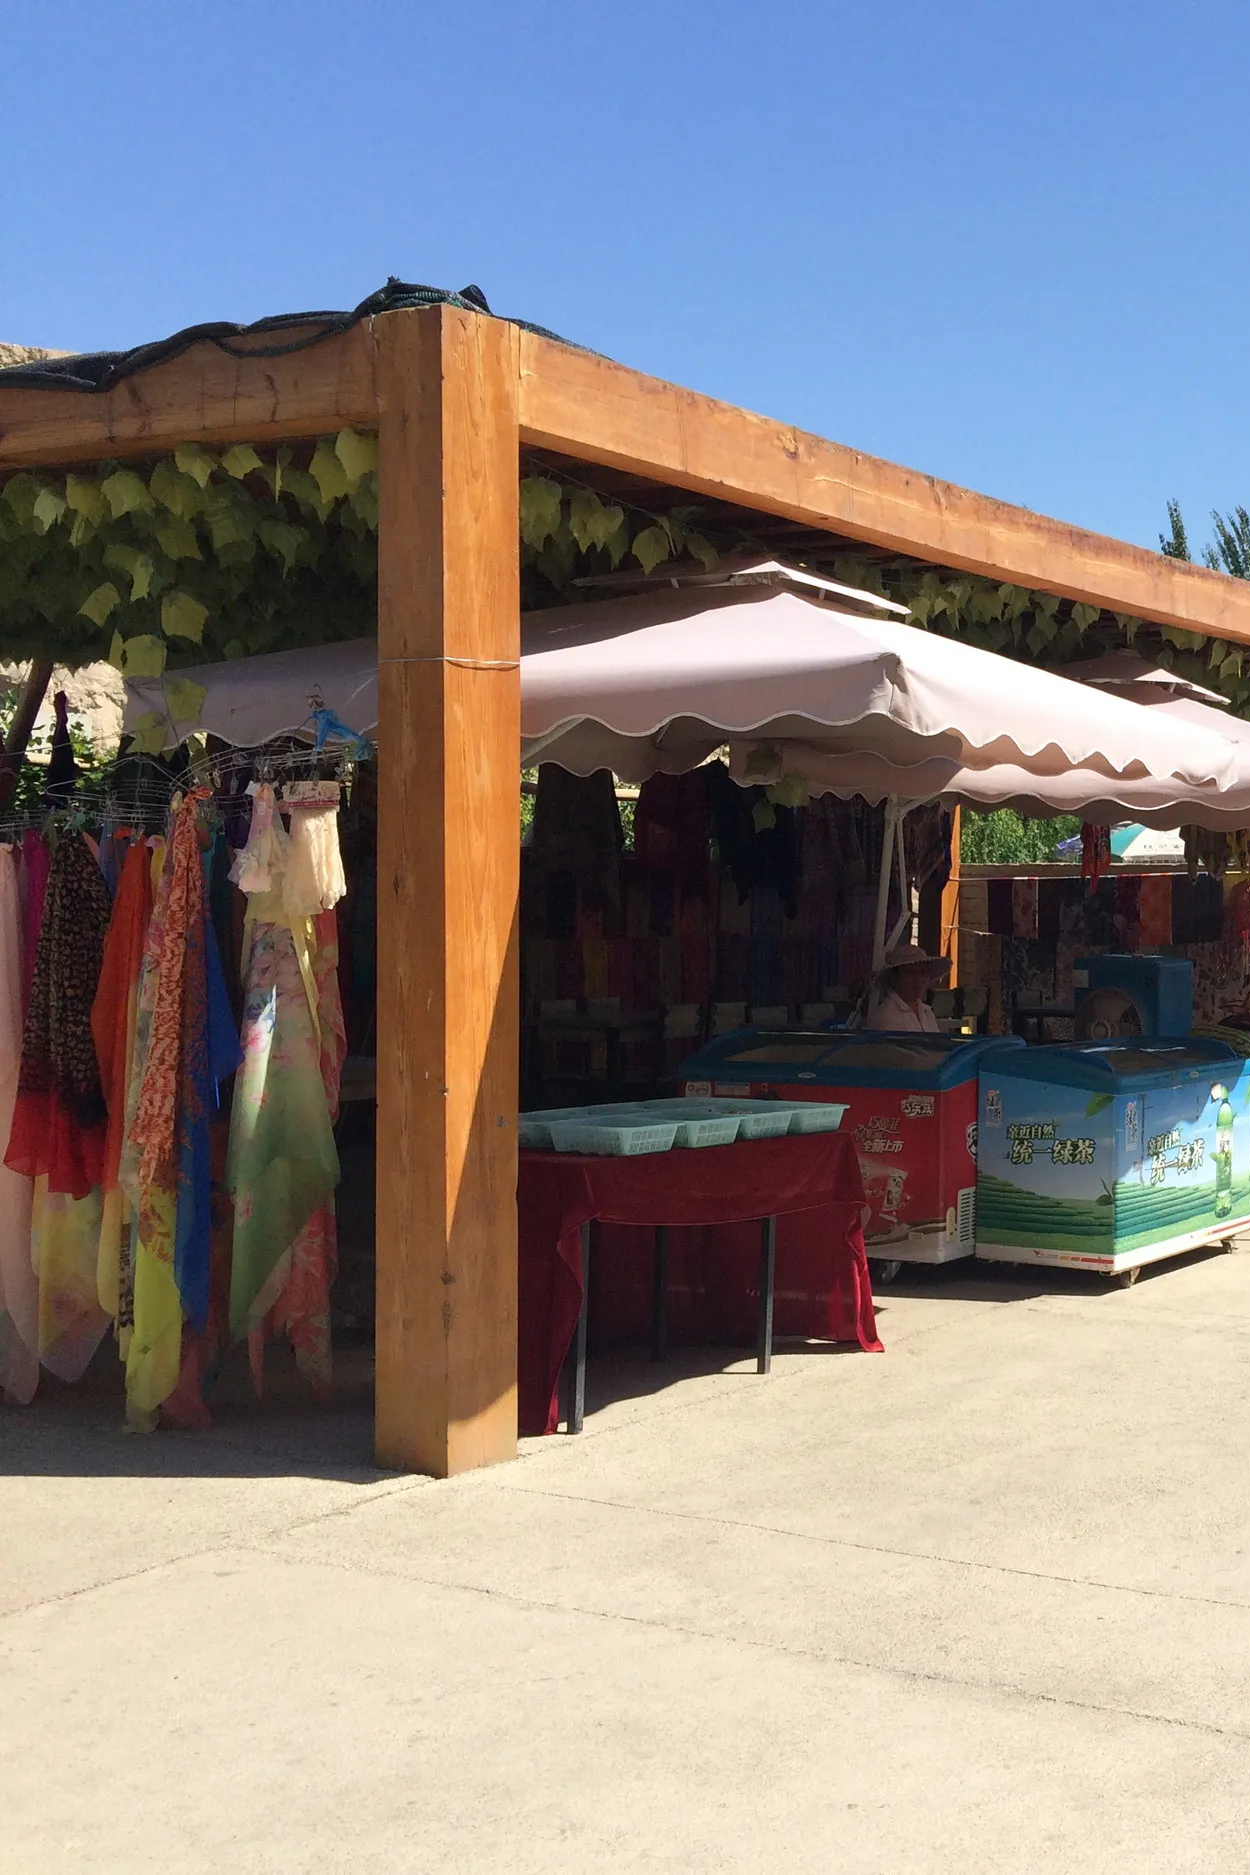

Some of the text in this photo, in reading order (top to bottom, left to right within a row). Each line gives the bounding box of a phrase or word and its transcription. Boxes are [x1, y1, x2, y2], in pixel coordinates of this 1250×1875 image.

[1011, 1139, 1096, 1165] 统一绿茶
[1150, 1138, 1205, 1186] 统一绿茶
